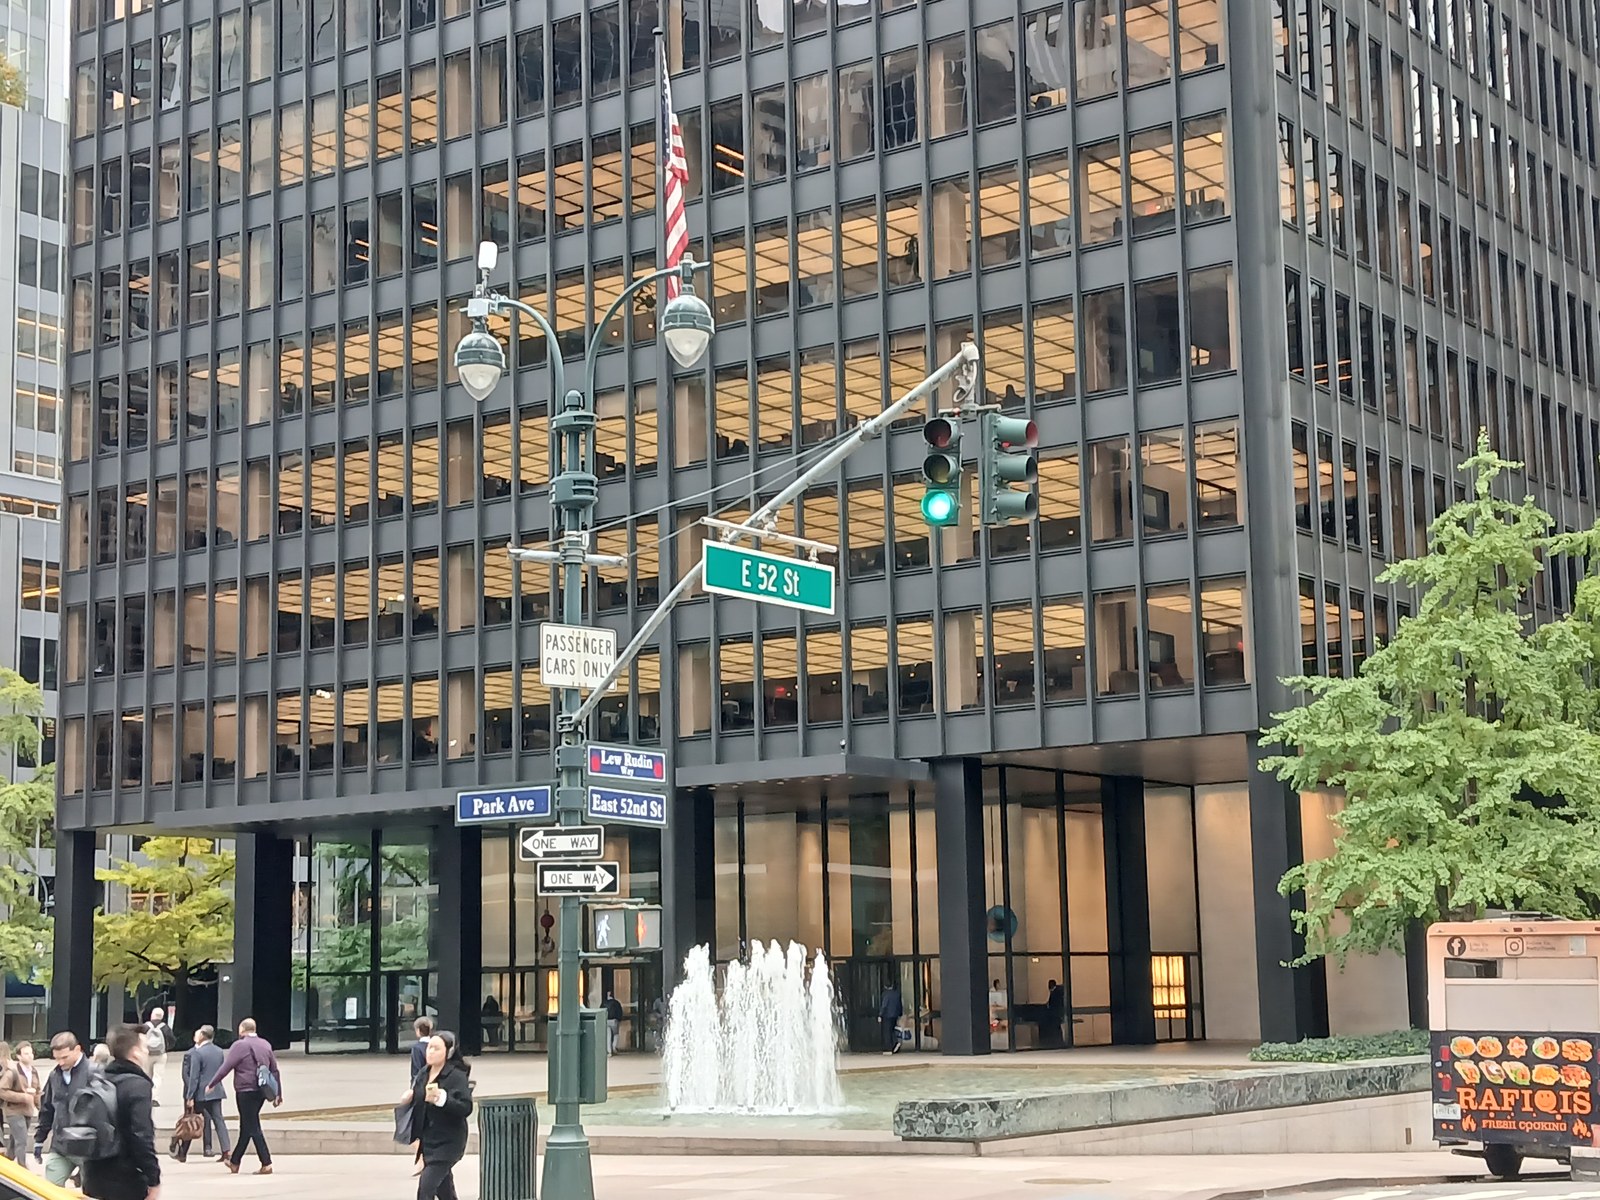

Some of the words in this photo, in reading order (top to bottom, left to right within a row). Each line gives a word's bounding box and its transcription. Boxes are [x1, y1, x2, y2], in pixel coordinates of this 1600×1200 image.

[742, 559, 751, 587] E
[758, 562, 778, 592] 52
[783, 568, 799, 597] St
[545, 633, 612, 657] PASSENGER
[545, 656, 576, 676] CARS
[583, 658, 611, 678] ONLY
[600, 750, 622, 767] Lew
[624, 752, 653, 769] Rudin
[620, 766, 634, 777] Way
[472, 797, 504, 816] Park
[508, 796, 535, 812] Ave
[592, 794, 618, 813] East
[620, 798, 647, 817] 52nd
[650, 803, 662, 818] St
[532, 838, 557, 849] ONE
[570, 836, 595, 848] WAY
[550, 873, 573, 885] ONE
[583, 873, 608, 884] WAY
[1518, 1120, 1567, 1132] COOKING
